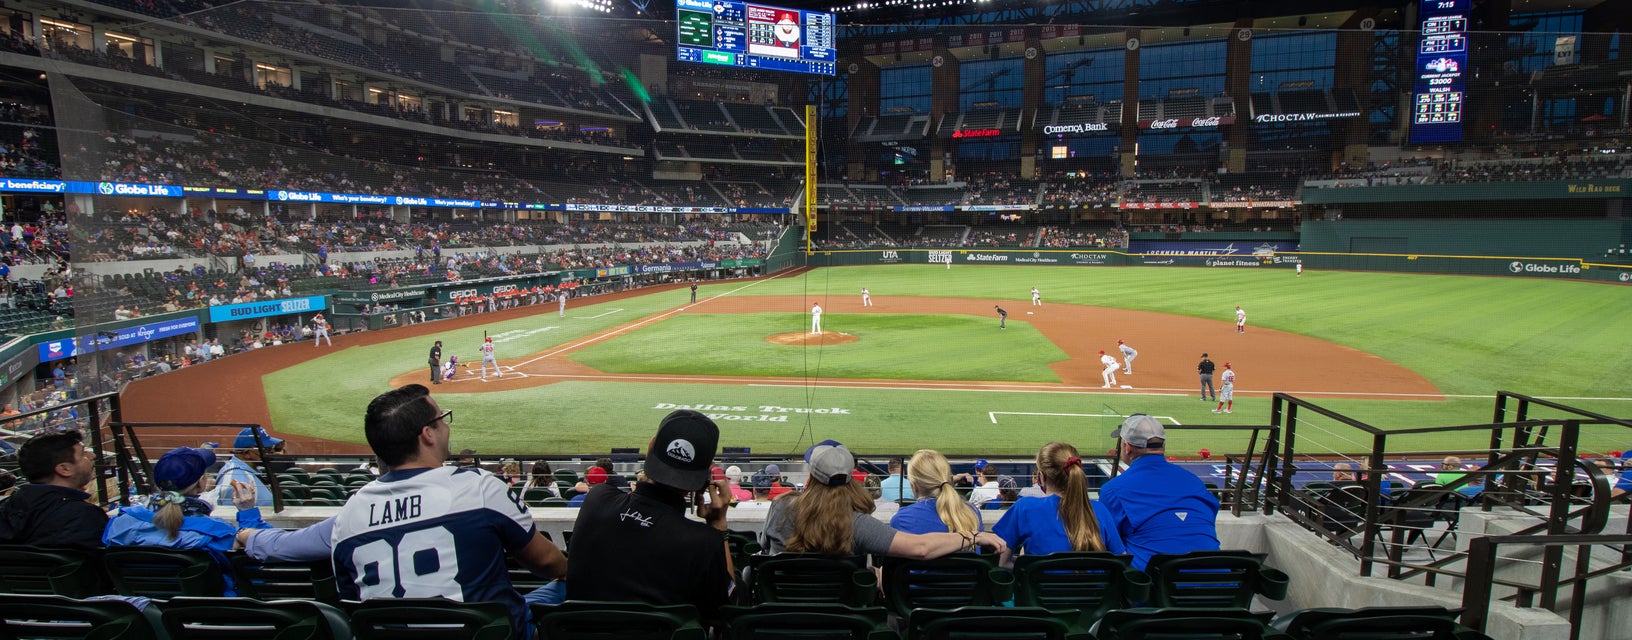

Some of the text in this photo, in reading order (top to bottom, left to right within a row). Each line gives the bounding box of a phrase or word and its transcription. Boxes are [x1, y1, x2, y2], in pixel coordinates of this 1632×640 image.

[1262, 113, 1315, 122] CHOCTAW
[1085, 122, 1108, 132] Bank
[8, 180, 66, 192] beneficiary?
[115, 184, 168, 195] Globe Life
[1525, 264, 1580, 274] Globe Life
[493, 284, 516, 293] GEICO
[450, 289, 477, 299] GEICO
[231, 298, 310, 316] BUD LIGHT SELTZER
[137, 327, 155, 340] Kroger
[653, 402, 851, 414] Dallas Truck
[704, 413, 788, 422] World
[368, 494, 422, 527] LAMB
